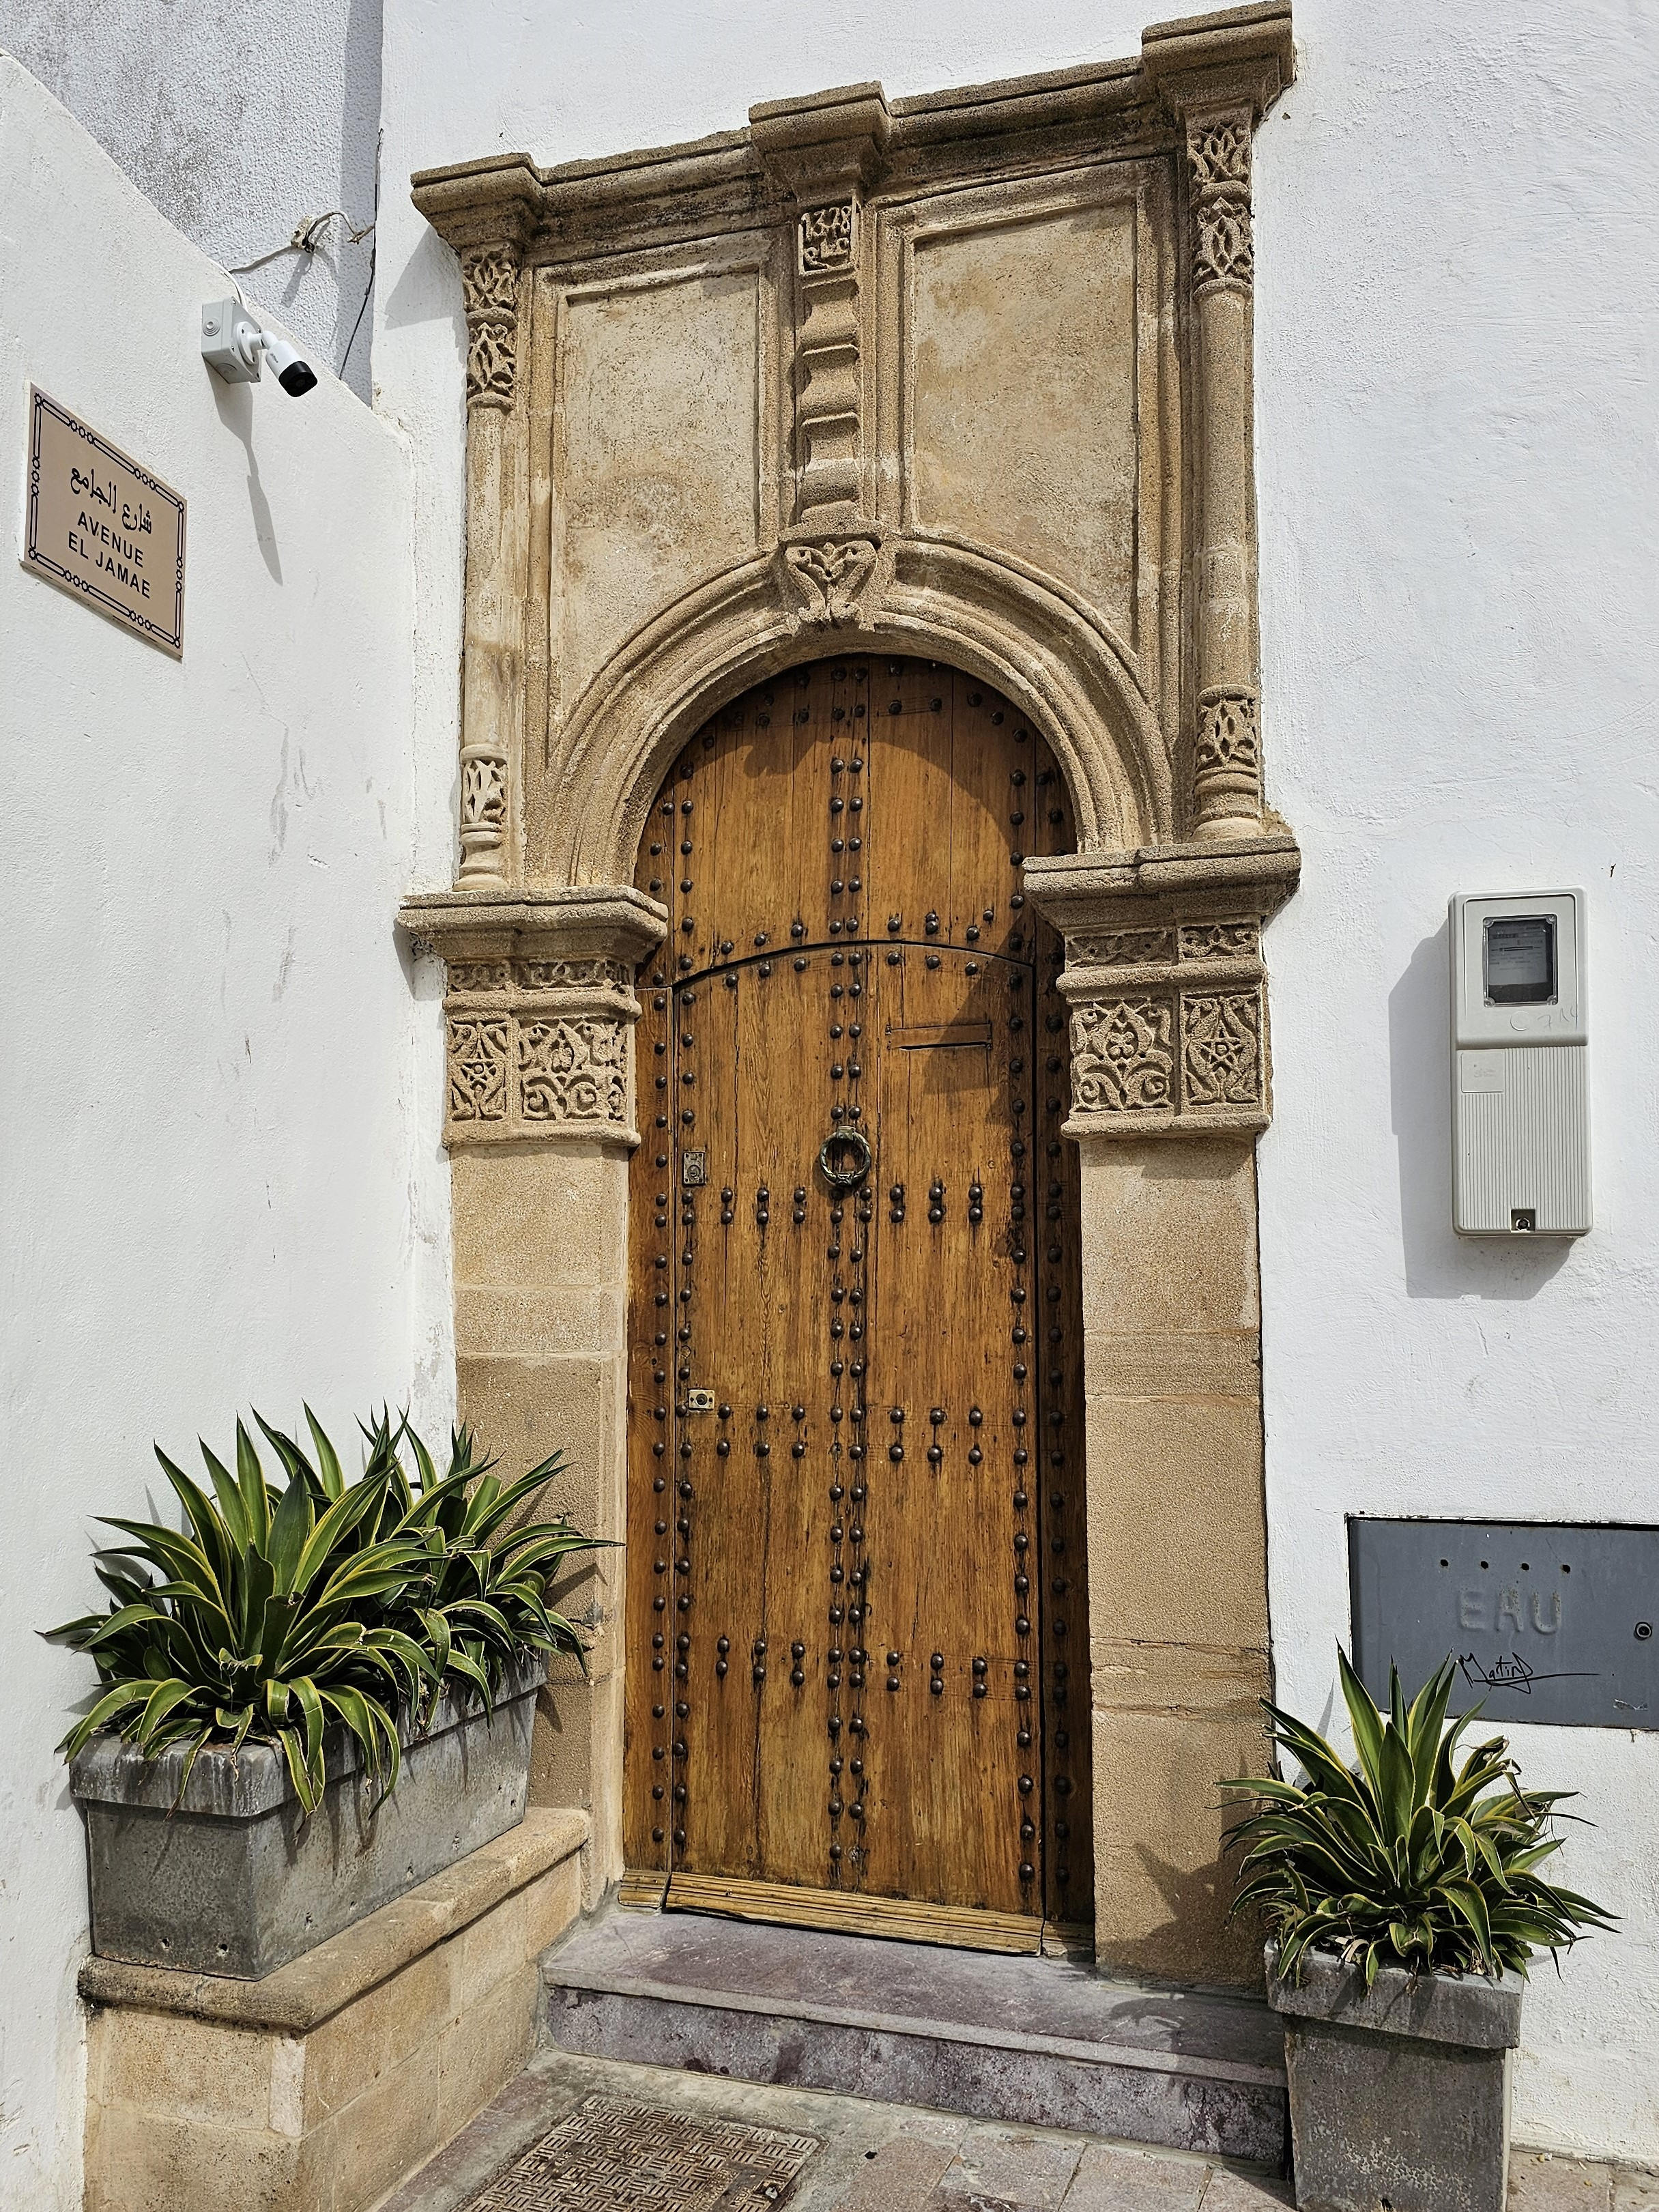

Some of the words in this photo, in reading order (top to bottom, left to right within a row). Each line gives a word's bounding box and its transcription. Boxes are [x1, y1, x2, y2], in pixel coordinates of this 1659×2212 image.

[70, 468, 117, 514] الجامع
[77, 511, 143, 569] AVENUE
[122, 503, 152, 534] شارع
[68, 530, 89, 560] EL
[95, 551, 150, 599] JAMAE
[1455, 1588, 1563, 1635] EAU
